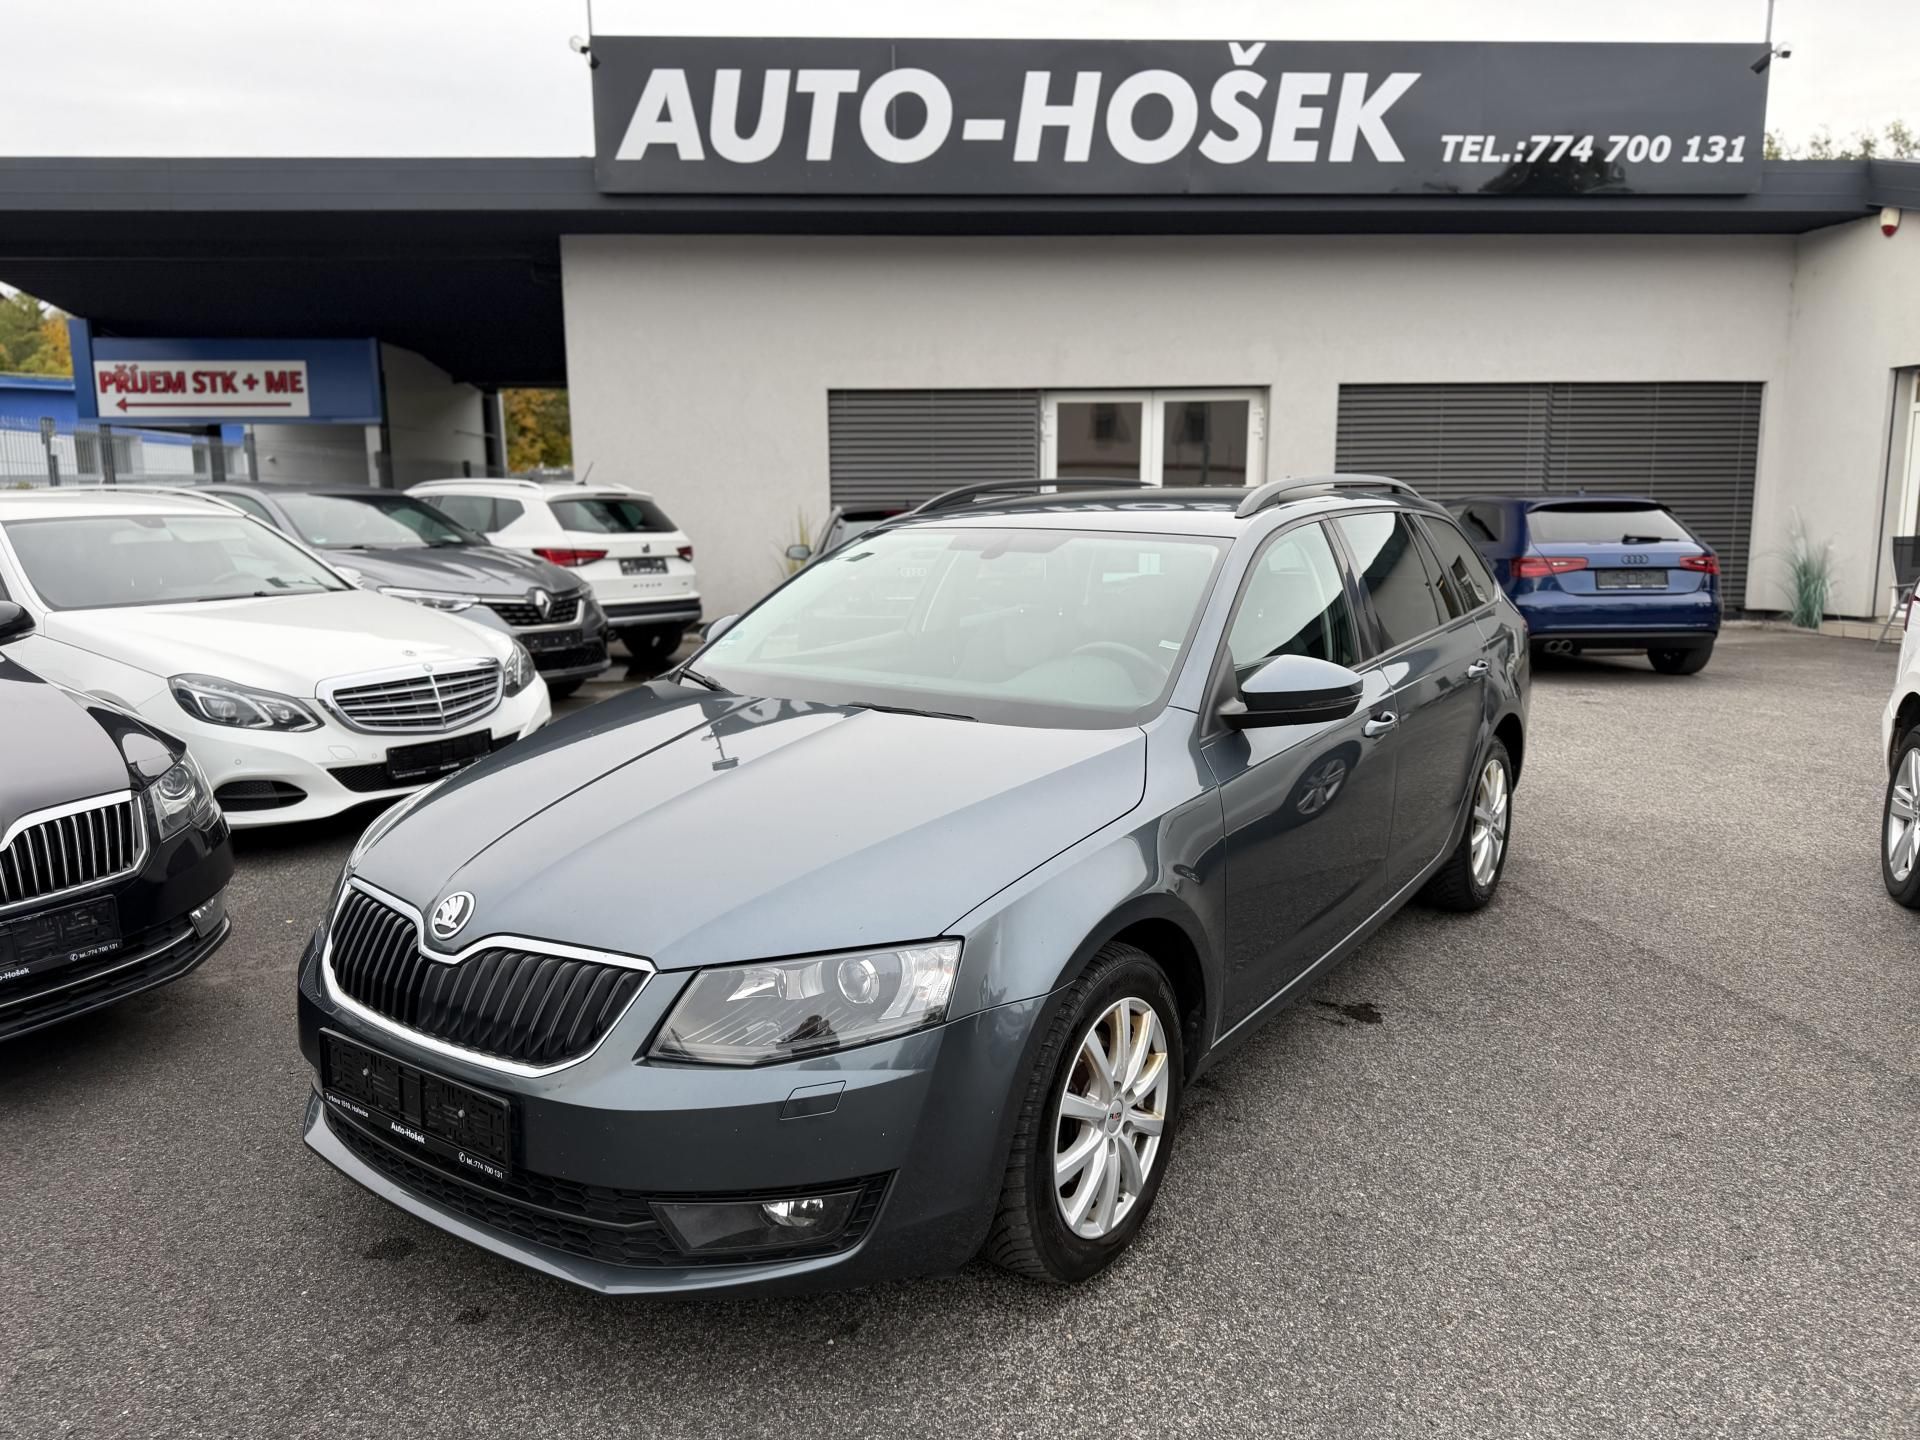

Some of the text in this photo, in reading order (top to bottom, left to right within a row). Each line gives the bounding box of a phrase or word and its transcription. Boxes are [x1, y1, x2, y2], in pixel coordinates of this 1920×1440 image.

[615, 41, 1422, 164] AUTO-HOŠEK
[1440, 134, 1746, 164] TEL.:774 700 131
[99, 363, 187, 394] PŘÍJEM
[192, 370, 239, 394] STK
[264, 370, 304, 394] ME
[390, 1121, 425, 1144] Auto-Hošek
[484, 1164, 494, 1175] 700
[494, 1169, 503, 1180] 131
